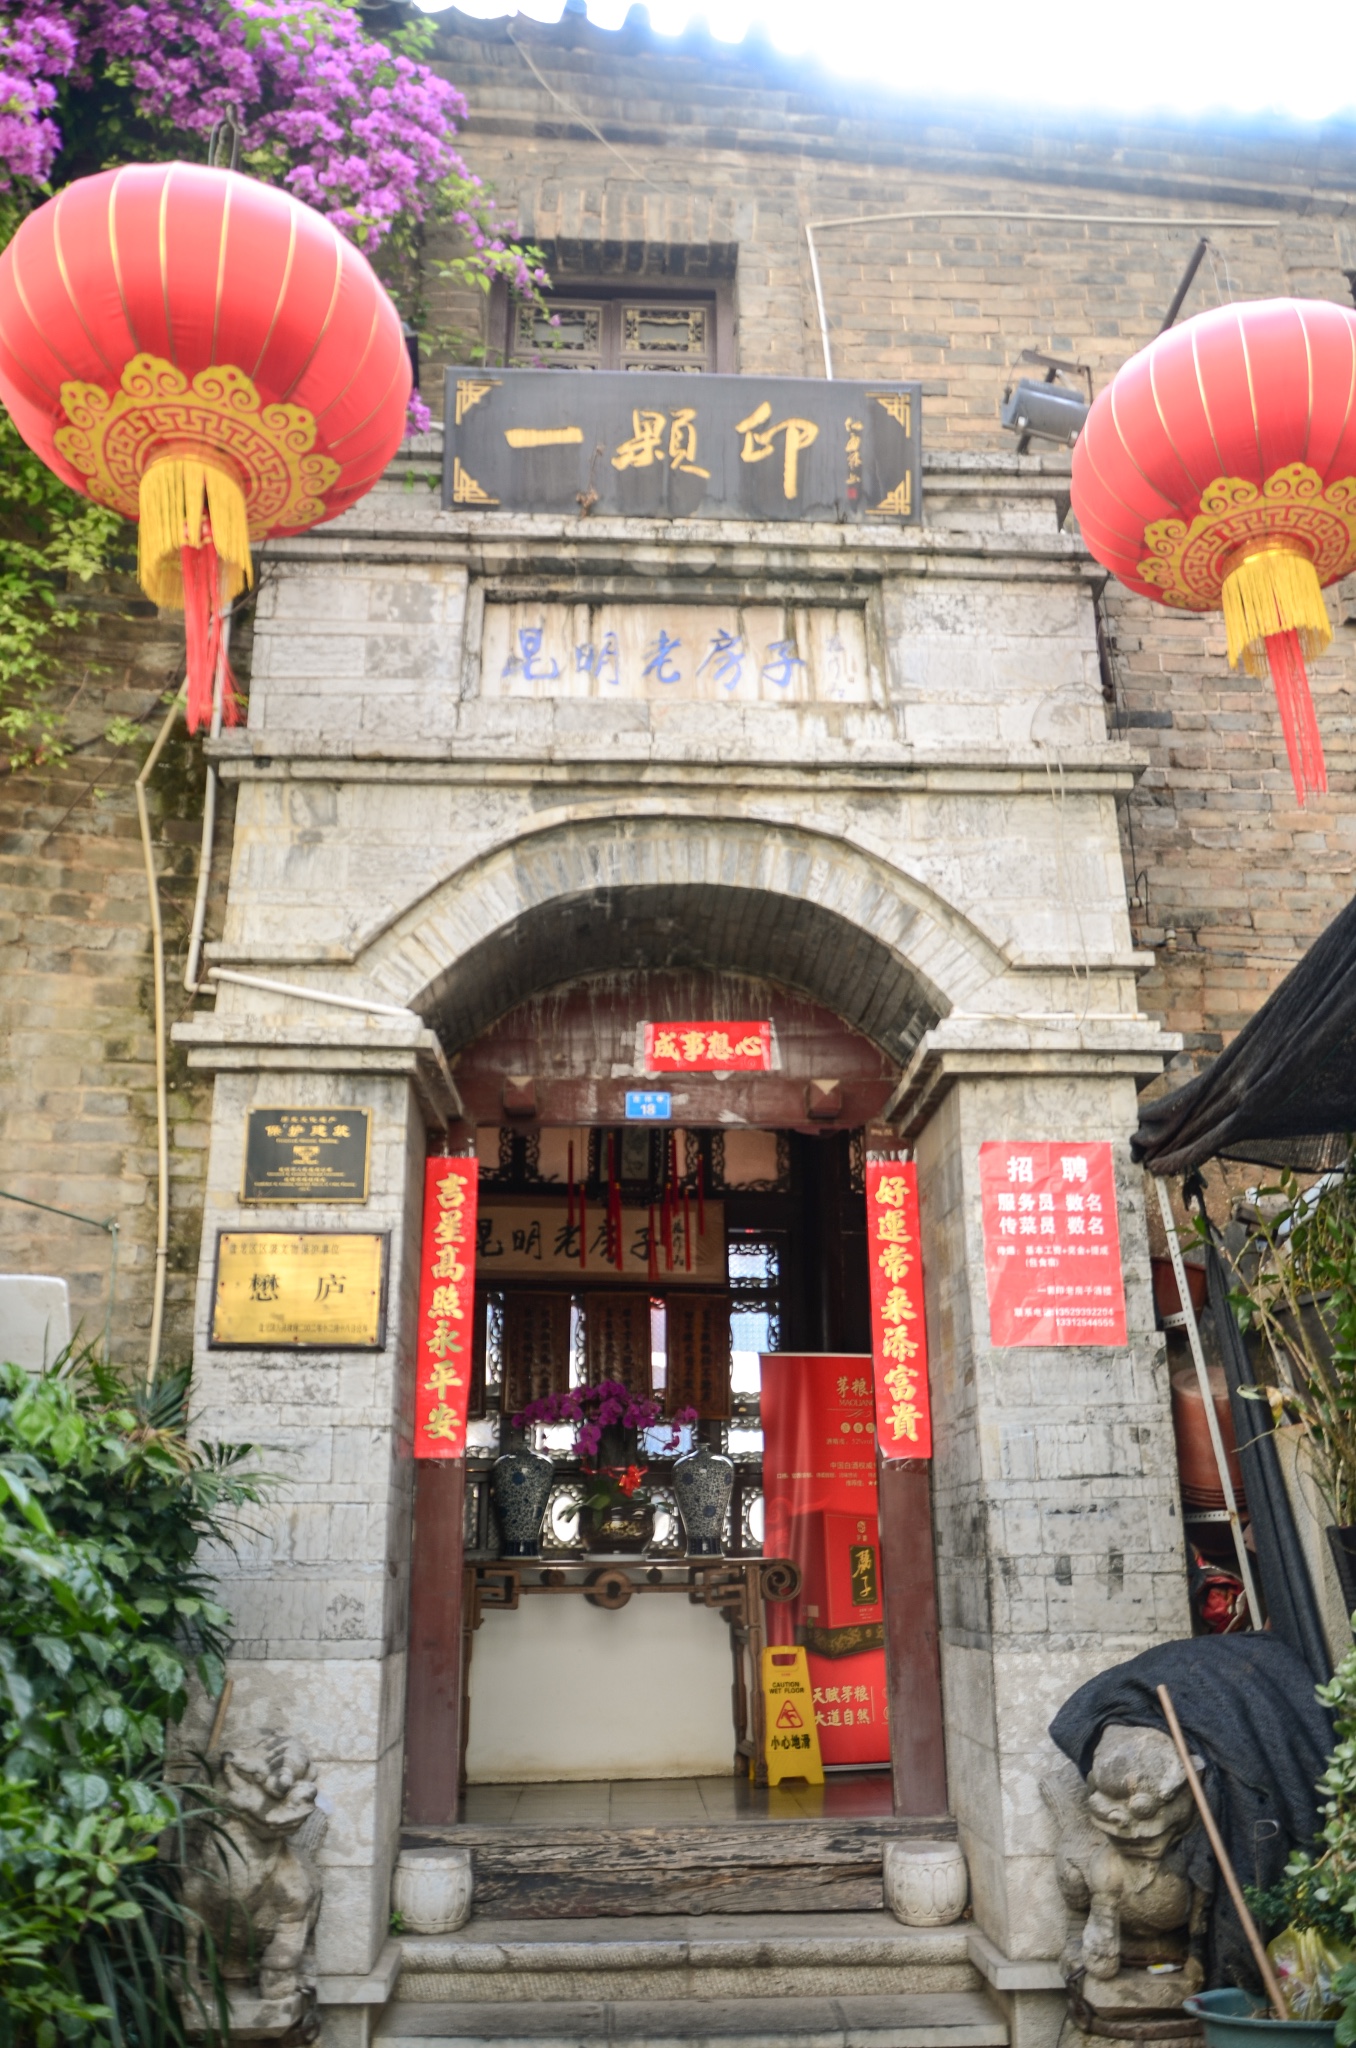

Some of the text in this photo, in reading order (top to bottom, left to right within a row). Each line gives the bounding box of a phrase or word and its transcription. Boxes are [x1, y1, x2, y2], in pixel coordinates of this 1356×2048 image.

[502, 627, 807, 691] 昆明老房子
[640, 1104, 656, 1116] 18
[1007, 1155, 1088, 1183] 招聘
[997, 1192, 1102, 1212] 服务员 数名
[999, 1216, 1104, 1235] 传菜员 数名
[249, 1273, 347, 1302] 懋庐
[423, 1172, 468, 1442] 吉星高照永平安
[836, 1376, 874, 1398] 茅粮
[771, 1733, 811, 1750] 小心地滑
